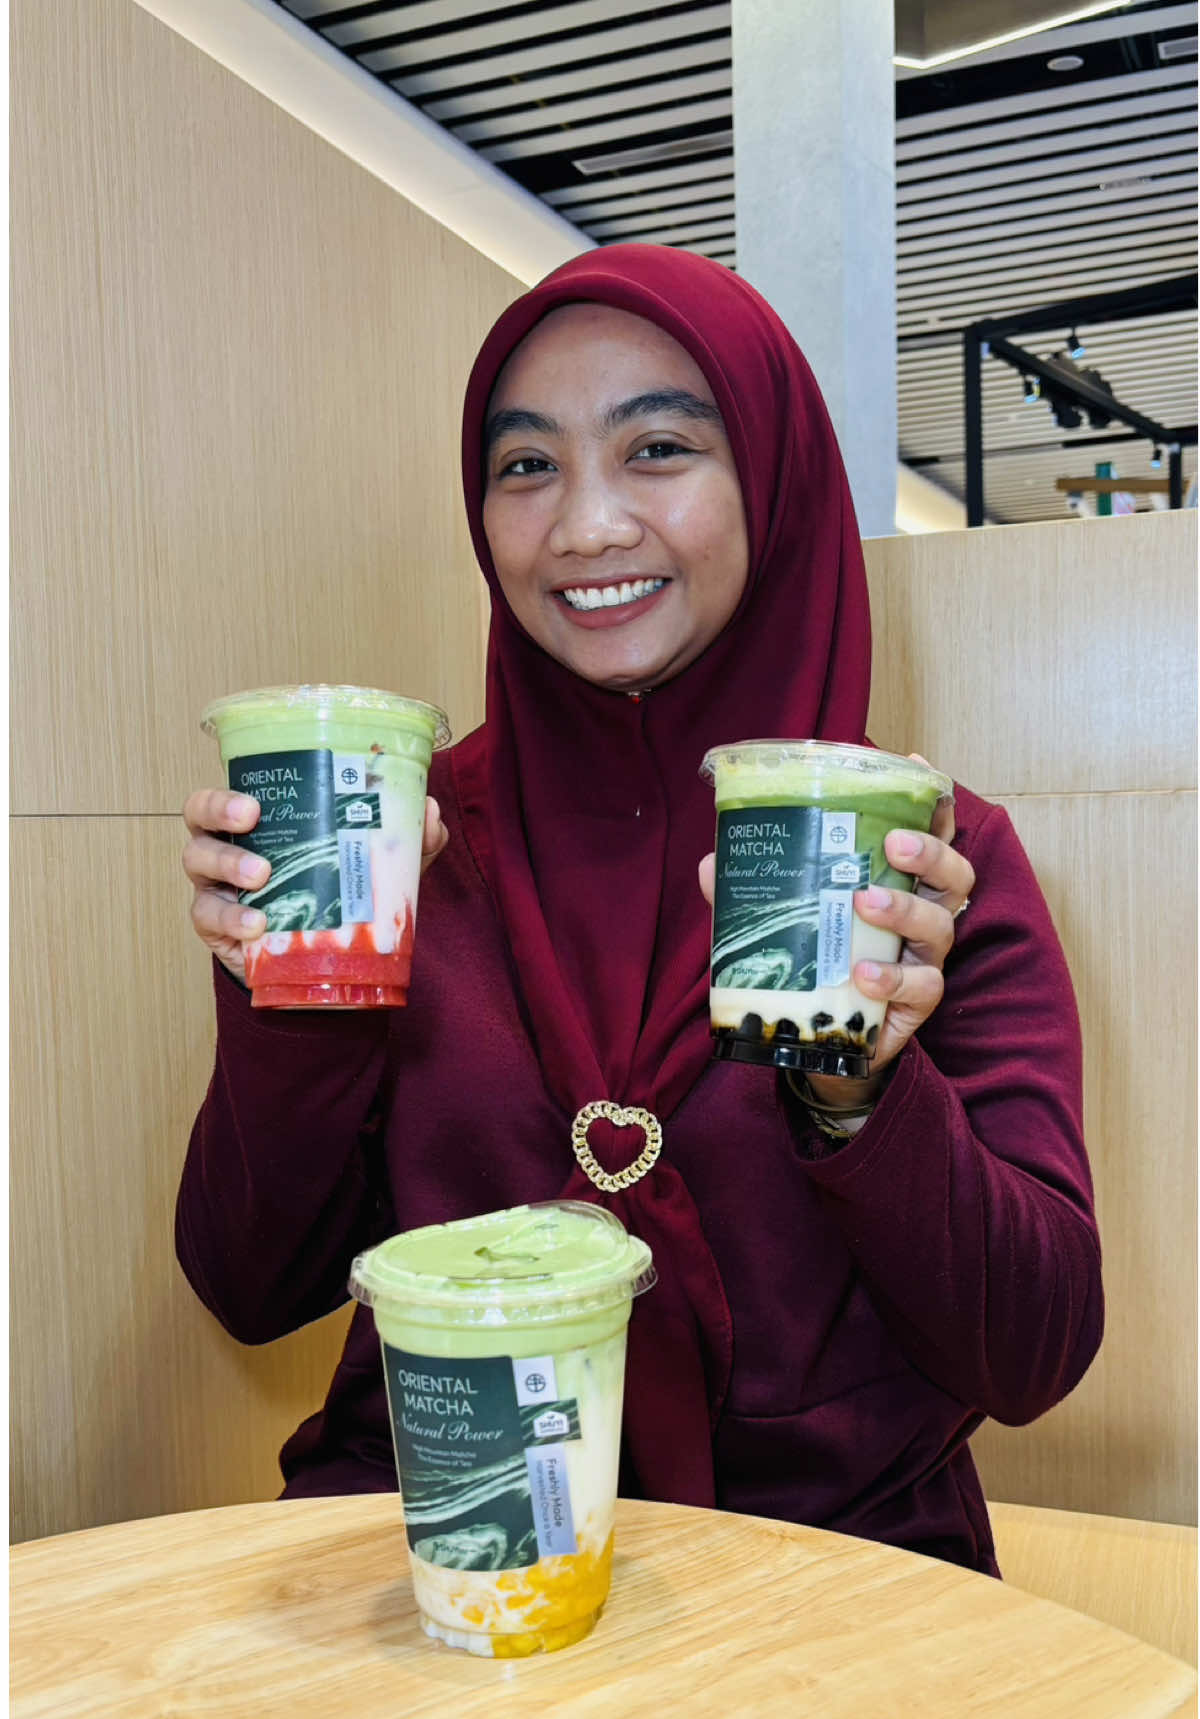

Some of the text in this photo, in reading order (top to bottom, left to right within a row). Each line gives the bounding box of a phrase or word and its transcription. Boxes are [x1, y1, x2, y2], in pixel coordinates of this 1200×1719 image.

[240, 767, 304, 786] ORIENTAL
[276, 803, 321, 822] Power
[727, 823, 791, 839] ORIENTAL
[729, 842, 785, 857] MATCHA
[354, 841, 364, 900] Freshly Made
[719, 860, 806, 879] Natural Power
[833, 903, 845, 963] Freshly Made
[398, 1369, 478, 1394] ORIENTAL
[403, 1392, 475, 1416] MATCHA
[397, 1412, 504, 1441] Natural Power
[546, 1458, 564, 1528] Freshly Made
